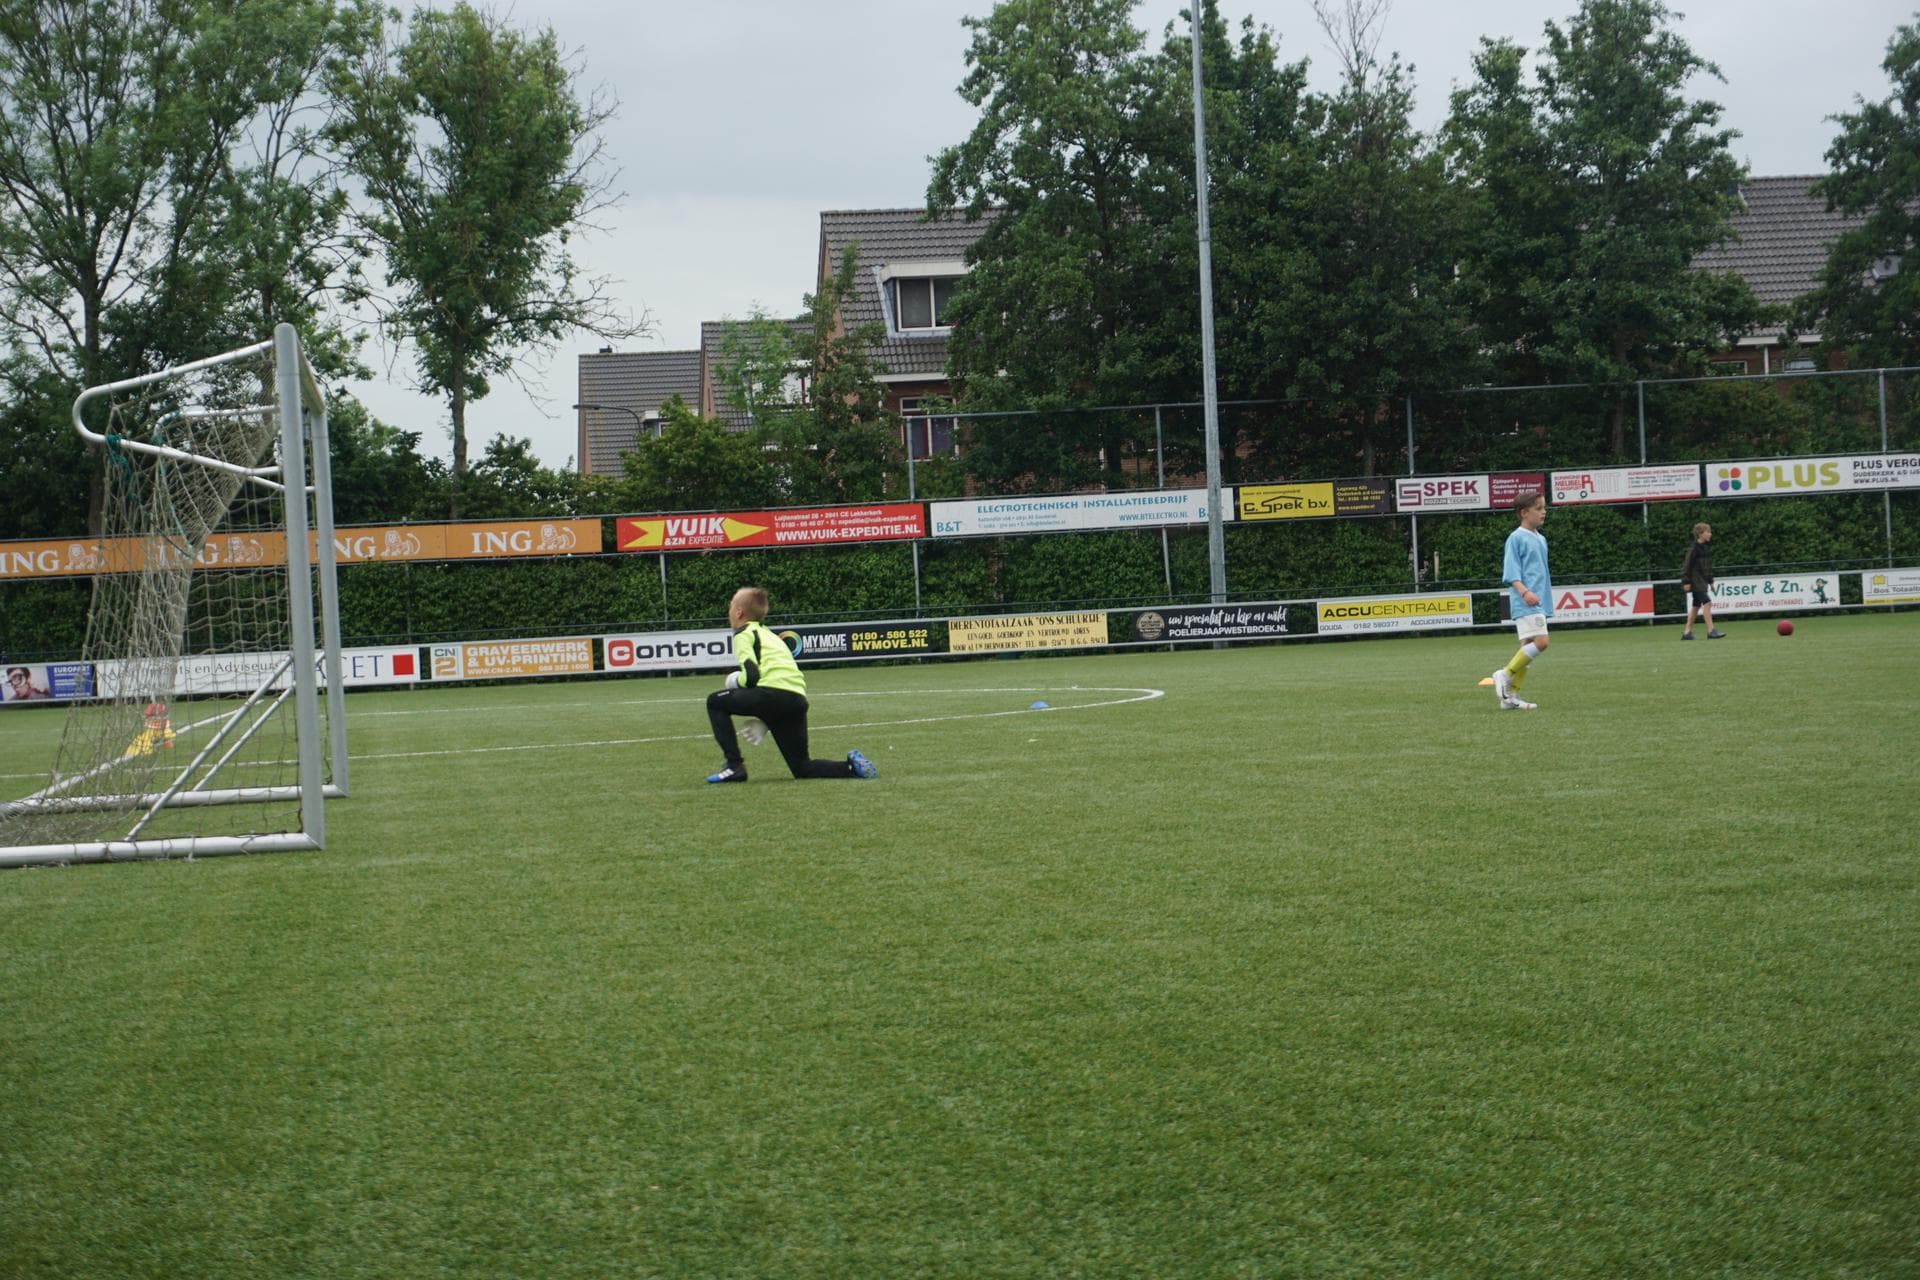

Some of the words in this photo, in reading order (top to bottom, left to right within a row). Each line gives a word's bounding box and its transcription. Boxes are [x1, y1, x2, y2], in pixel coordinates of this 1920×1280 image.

[1853, 460, 1883, 469] PLUS
[1886, 458, 1920, 468] VERG
[1747, 462, 1841, 490] PLUS
[1423, 480, 1479, 497] SPEK
[977, 501, 1079, 513] ELECTROTECHNISCH
[1083, 495, 1189, 509] INSTALLATIEBEDRIJF
[1261, 496, 1304, 514] Spek
[1118, 511, 1188, 521] WWW.BTELECTRO.NL
[664, 516, 727, 537] VUIK
[775, 523, 922, 542] WWW.VUIK-EXPEDITIE.NL
[935, 520, 962, 533] B&T
[471, 529, 533, 555] ING
[664, 537, 686, 546] &ZN
[688, 535, 725, 545] EXPEDITIE
[0, 550, 60, 574] ING
[1713, 582, 1757, 597] Visser
[1763, 580, 1775, 594] &
[1780, 580, 1804, 593] Zn.
[1168, 615, 1184, 626] uw
[1183, 608, 1224, 628] specialist
[1224, 612, 1236, 623] in
[1236, 608, 1252, 625] kip
[1253, 614, 1266, 622] en
[1267, 605, 1288, 622] wild
[1323, 601, 1457, 619] ACCUCENTRALE
[950, 615, 1034, 632] DIERENTOTAALZAAK
[1353, 622, 1371, 630] 0182
[1410, 617, 1471, 627] ACCUCENTRALE.NL
[802, 635, 819, 649] MY
[819, 633, 847, 648] MOVE
[851, 631, 878, 641] 0180
[908, 629, 928, 638] 522
[996, 630, 1024, 639] GOEDKOOP
[1027, 629, 1035, 638] EN
[434, 648, 456, 657] CN
[466, 641, 588, 658] GRAVEERWERK
[609, 635, 734, 667] Control
[852, 637, 929, 652] MYMOVE.NL
[194, 664, 211, 674] en
[214, 661, 280, 674] Adviseurs
[434, 657, 458, 677] 2
[467, 657, 480, 669] &
[484, 651, 590, 666] UV-PRINTING
